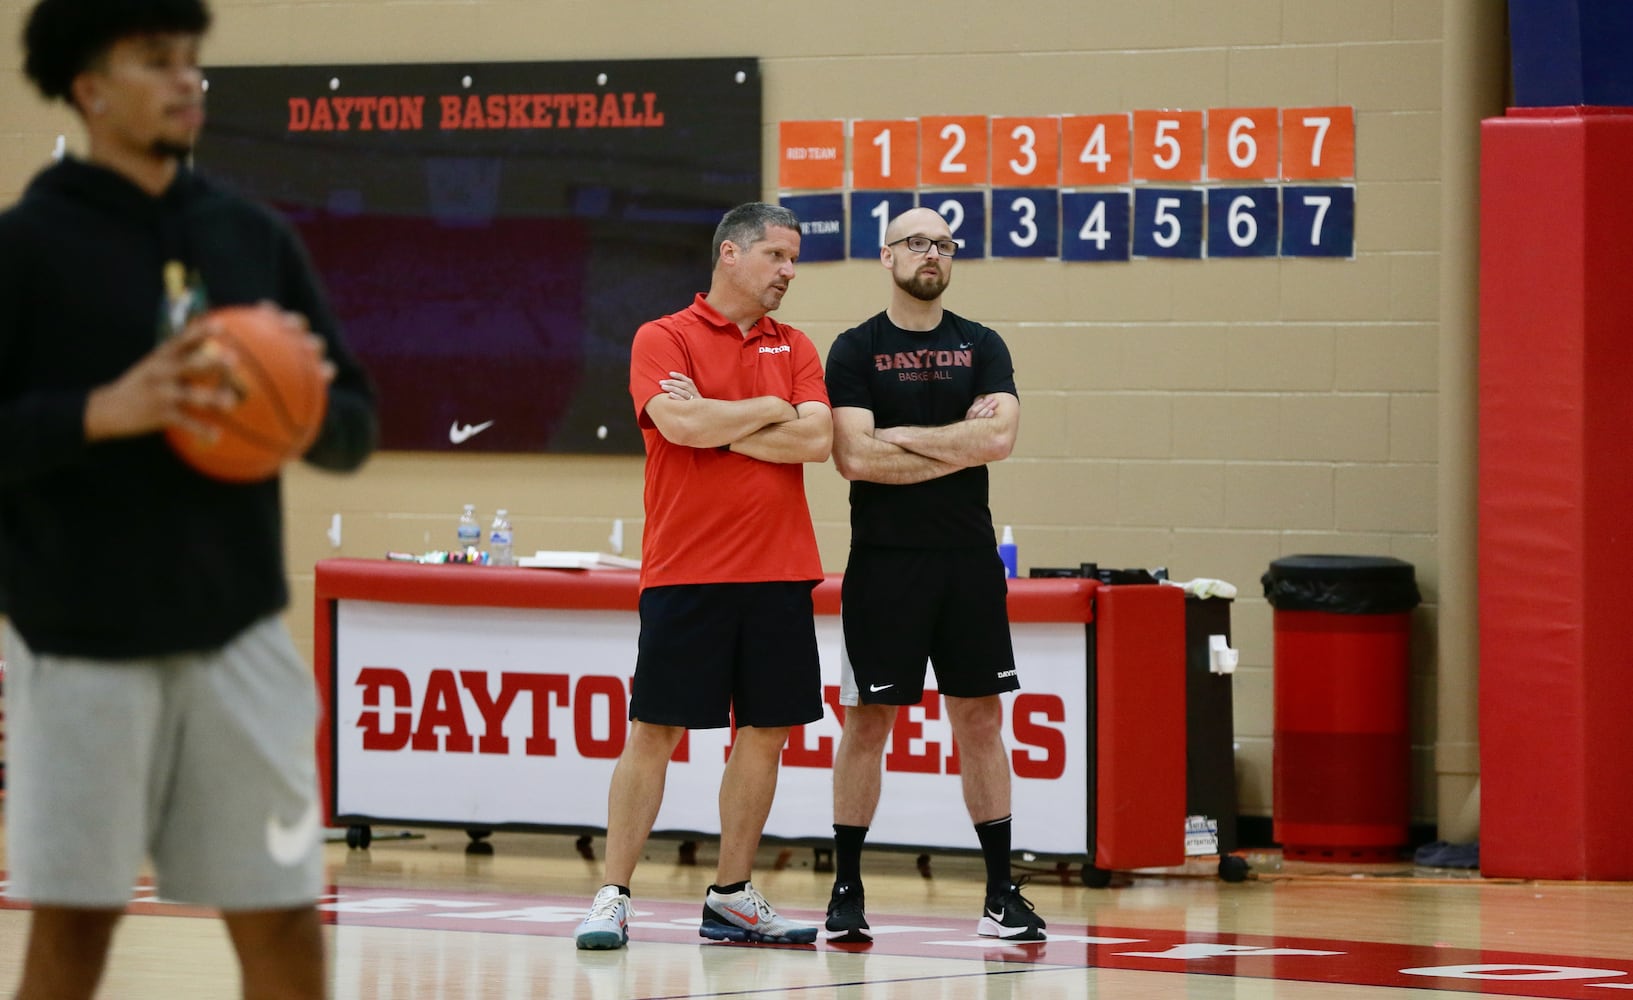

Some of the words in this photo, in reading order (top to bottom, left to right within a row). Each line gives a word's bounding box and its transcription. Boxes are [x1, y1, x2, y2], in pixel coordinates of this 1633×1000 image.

[288, 96, 425, 131] DAYTON
[440, 92, 664, 130] BASKETBALL
[786, 147, 806, 159] RED
[808, 147, 837, 160] TEAM
[873, 129, 891, 178] 1
[939, 123, 967, 173] 2
[1009, 124, 1038, 176] 3
[1079, 123, 1111, 173] 4
[1152, 119, 1181, 170] 5
[1227, 116, 1258, 169] 6
[1302, 116, 1331, 167] 7
[811, 220, 840, 233] TEAM
[871, 200, 890, 248] 1
[938, 199, 966, 249] 2
[1009, 197, 1038, 248] 3
[1079, 200, 1111, 250] 4
[1152, 196, 1181, 248] 5
[1227, 195, 1258, 247] 6
[1302, 196, 1332, 246] 7
[874, 349, 973, 371] DAYTON
[355, 666, 690, 763] DAYTO
